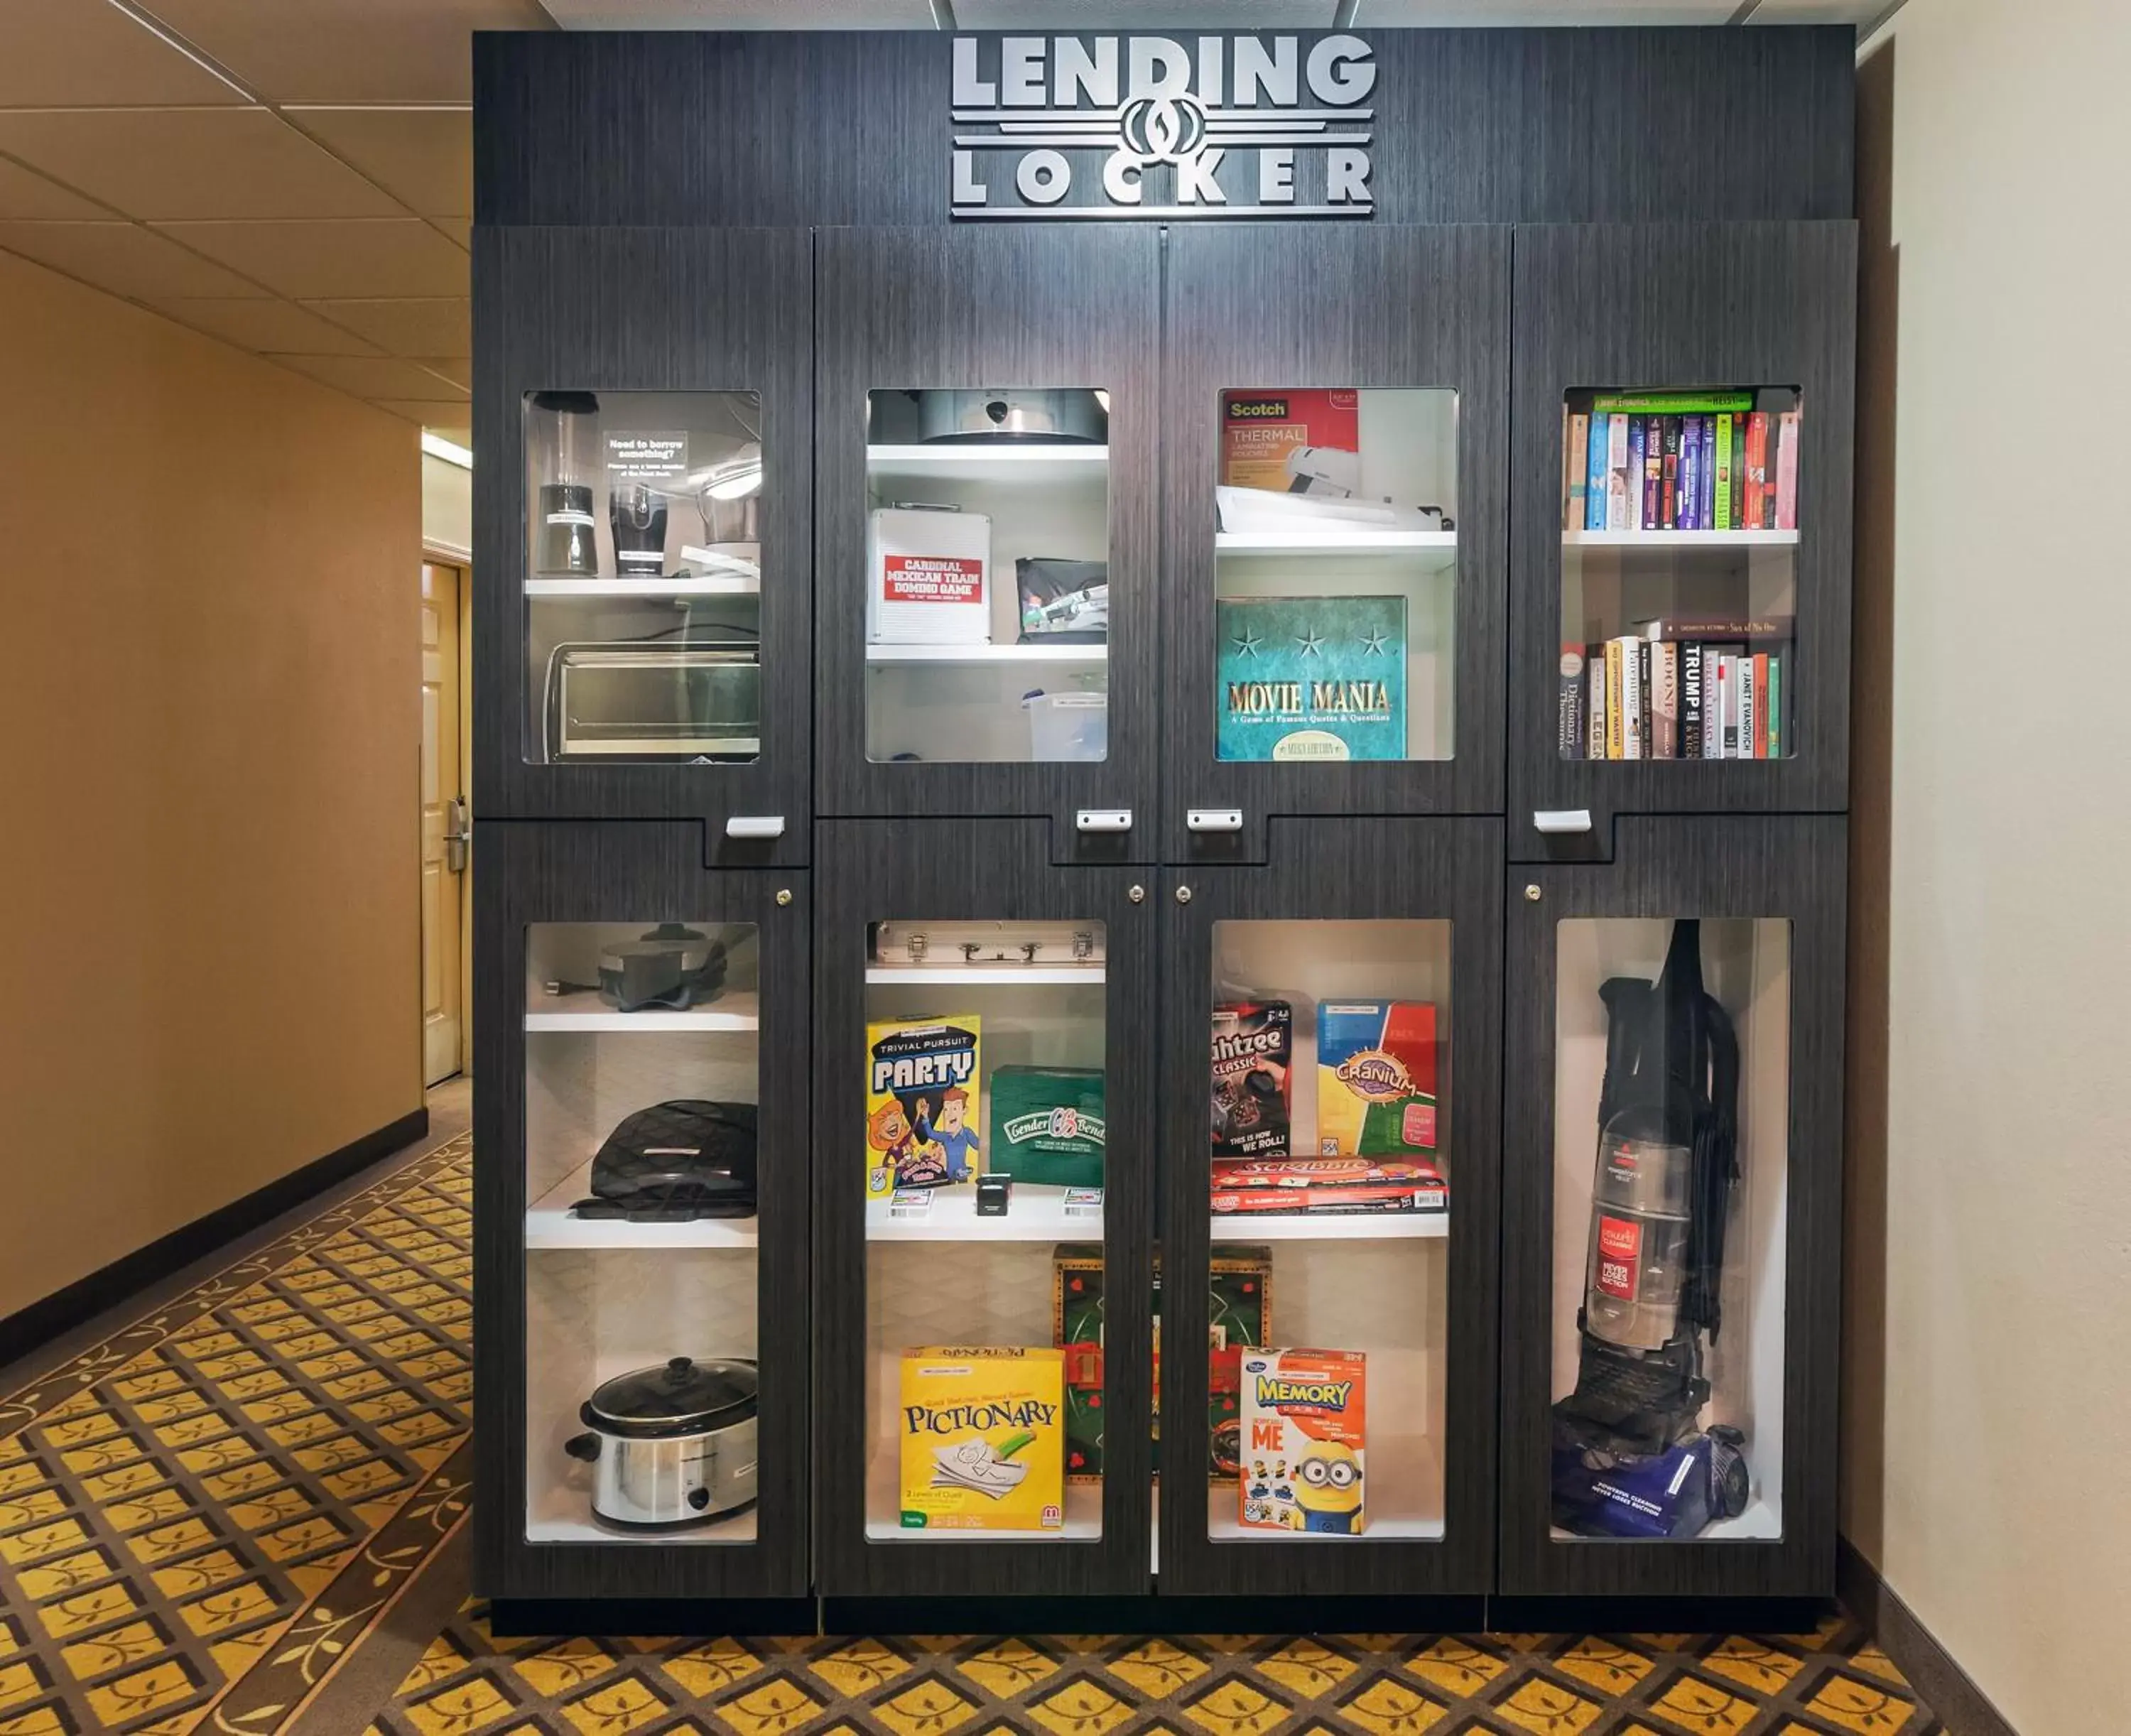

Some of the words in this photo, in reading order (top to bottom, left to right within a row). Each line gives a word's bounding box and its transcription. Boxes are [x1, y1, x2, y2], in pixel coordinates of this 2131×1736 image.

[953, 34, 1376, 107] LENDING
[953, 147, 1373, 205] LOCKER
[1231, 403, 1285, 416] Scotch
[609, 440, 635, 449] Need
[636, 440, 648, 449] to
[649, 440, 684, 449] borrow
[1232, 429, 1305, 443] THERMAL
[619, 449, 675, 460] something?
[904, 560, 963, 572] CARDINAL
[886, 570, 942, 582] MEXICAN
[943, 573, 980, 585] TRAIN
[894, 582, 938, 593] DOMINO
[940, 584, 972, 595] GAME
[1686, 646, 1700, 708] TRUMP
[1228, 682, 1302, 715] MOVIE
[1312, 681, 1392, 714] MANIA
[1276, 715, 1308, 723] Famous
[1309, 715, 1338, 724] Quotes
[1349, 714, 1391, 723] Questions
[1566, 684, 1578, 747] Dictionary
[1743, 702, 1752, 751] EVANOVICH
[880, 1041, 921, 1053] TRIVIAL
[923, 1036, 968, 1048] PURSUIT
[874, 1051, 972, 1091] PARTY
[1213, 1056, 1257, 1075] CLASSIC
[1011, 1119, 1048, 1138] Gender
[1230, 1136, 1246, 1146] THIS
[1247, 1134, 1254, 1143] IS
[1255, 1131, 1271, 1140] HOW
[1242, 1141, 1257, 1152] WE
[1259, 1135, 1285, 1149] ROLL!
[1257, 1375, 1352, 1406] MEMORY
[904, 1400, 1058, 1435] PICTIONARY
[1252, 1423, 1284, 1451] ME
[1592, 1485, 1612, 1497] NEVER
[1612, 1494, 1631, 1506] LOSES
[1632, 1502, 1659, 1517] SUCTION
[1630, 1495, 1662, 1512] CLEANING
